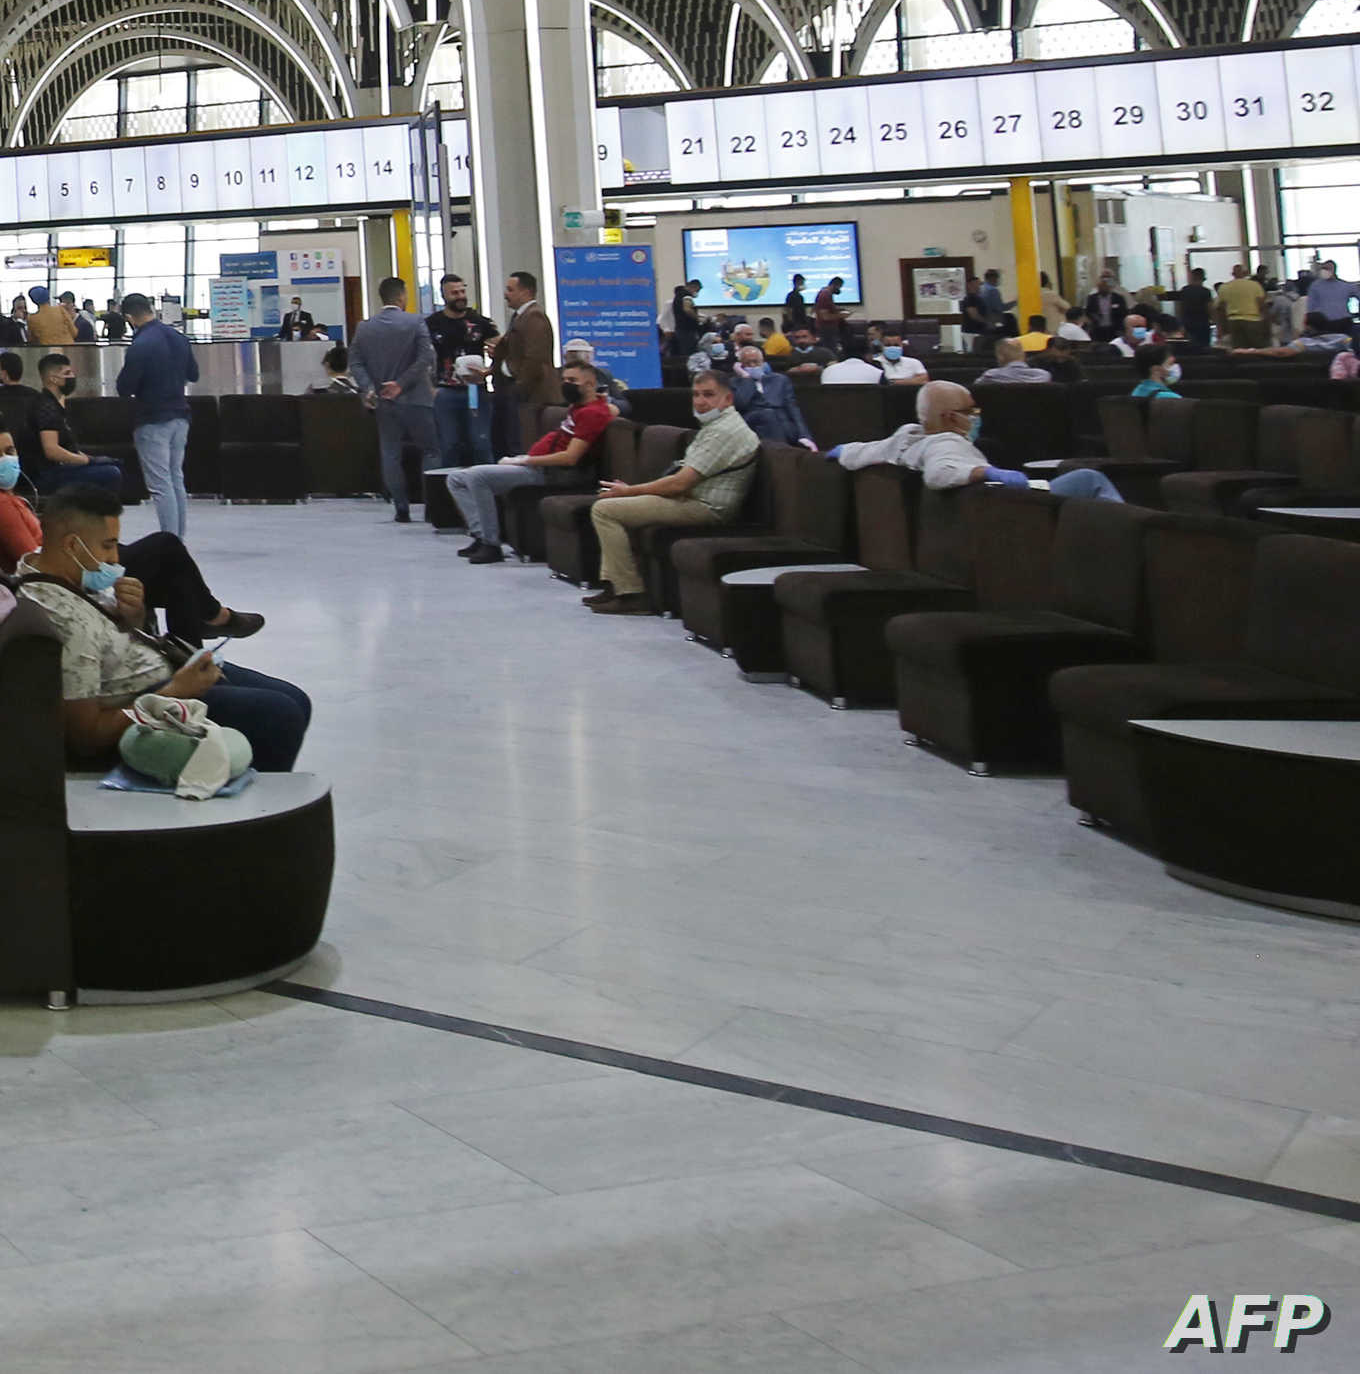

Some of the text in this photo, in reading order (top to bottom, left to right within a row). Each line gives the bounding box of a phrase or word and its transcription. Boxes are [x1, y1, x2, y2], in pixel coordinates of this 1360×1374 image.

[681, 137, 704, 155] 21
[730, 135, 757, 154] 22
[781, 129, 809, 149] 23
[829, 126, 857, 145] 24
[879, 122, 908, 142] 25
[938, 119, 968, 140] 26
[992, 114, 1022, 134] 27
[1052, 109, 1083, 130] 28
[1113, 105, 1144, 126] 29
[1176, 100, 1208, 122] 30
[1234, 96, 1264, 118] 31
[1301, 91, 1335, 113] 32
[28, 185, 37, 198] 4
[60, 182, 70, 197] 5
[89, 180, 99, 196] 6
[125, 178, 134, 193] 7
[157, 175, 166, 191] 8
[189, 173, 200, 189] 9
[224, 170, 243, 186] 10
[259, 167, 275, 184] 11
[294, 164, 315, 181] 12
[335, 162, 356, 178] 13
[373, 159, 393, 176] 14
